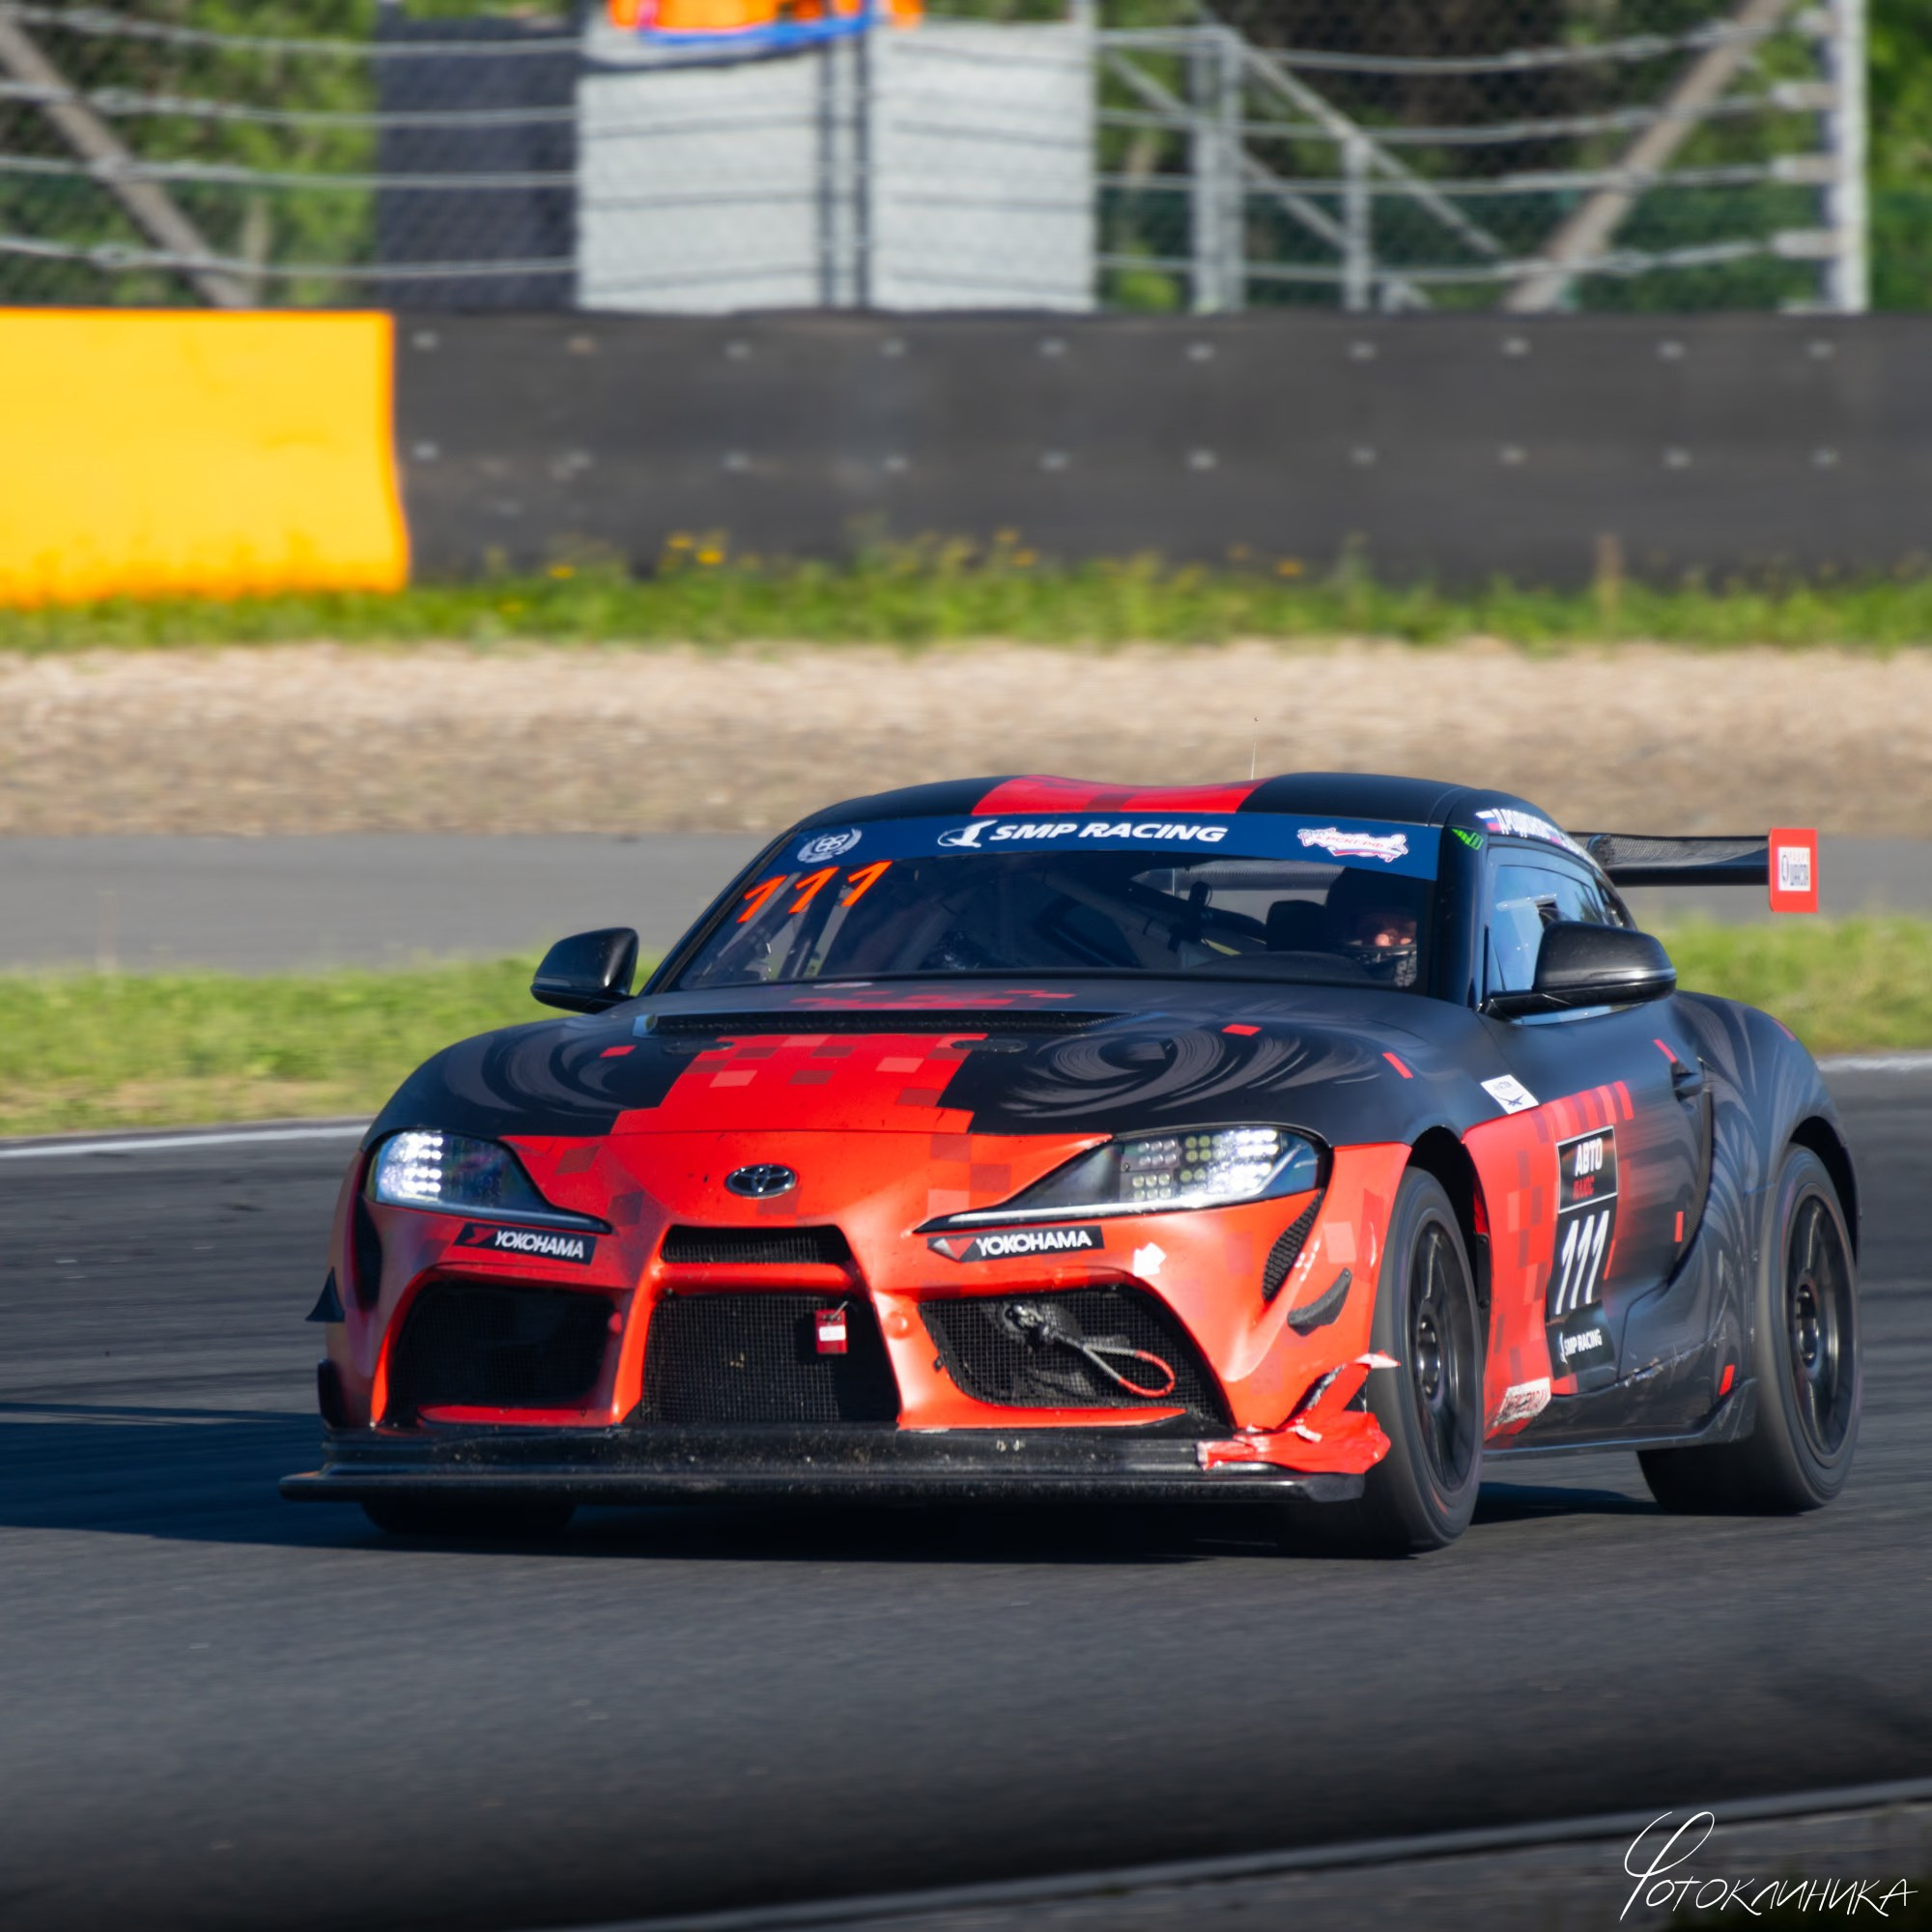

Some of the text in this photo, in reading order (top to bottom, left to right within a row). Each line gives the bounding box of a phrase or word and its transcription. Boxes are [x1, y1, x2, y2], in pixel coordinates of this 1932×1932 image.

[989, 822, 1228, 842] SMP RACING
[736, 859, 894, 923] 111
[1575, 1137, 1604, 1178] АВТО
[495, 1230, 584, 1259] YOKOHAMA
[976, 1230, 1093, 1256] YOKOHAMA
[1555, 1209, 1610, 1316] 111
[1563, 1328, 1604, 1357] SMP RACING
